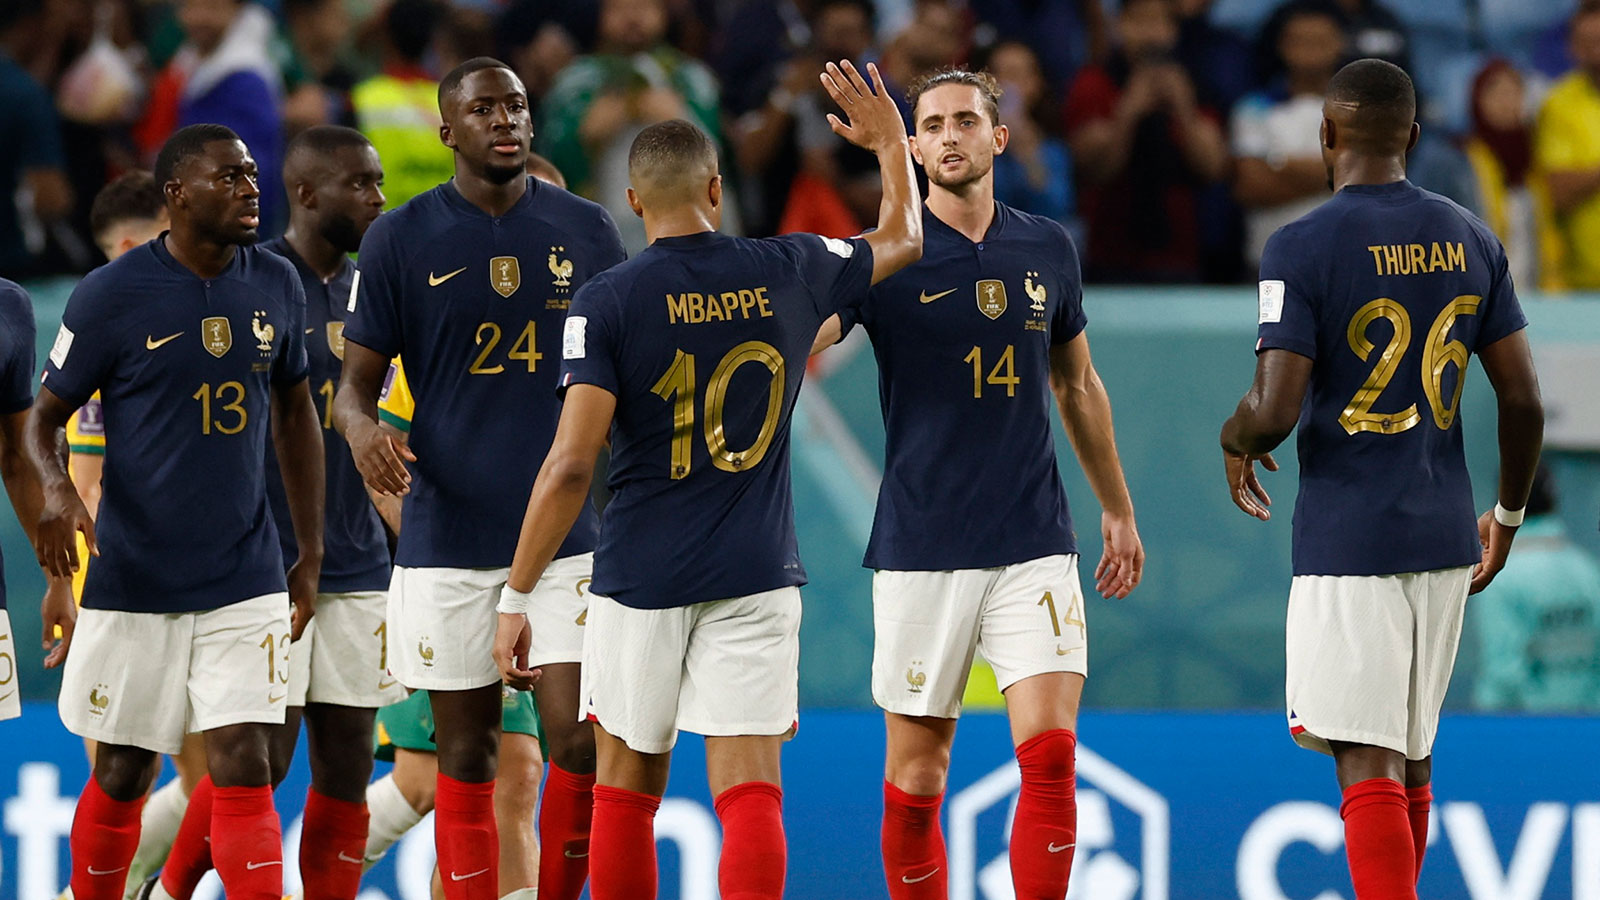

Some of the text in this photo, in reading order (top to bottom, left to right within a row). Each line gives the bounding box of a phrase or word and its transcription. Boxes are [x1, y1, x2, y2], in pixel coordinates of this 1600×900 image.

[1368, 242, 1466, 276] THURAM
[666, 287, 773, 324] MBAPPE
[469, 320, 543, 374] 24
[963, 344, 1020, 398] 14
[1338, 295, 1482, 436] 26
[192, 381, 247, 435] 13
[319, 379, 334, 429] 1
[650, 341, 786, 480] 10
[1037, 591, 1085, 640] 14
[260, 632, 291, 685] 13
[373, 621, 387, 670] 1
